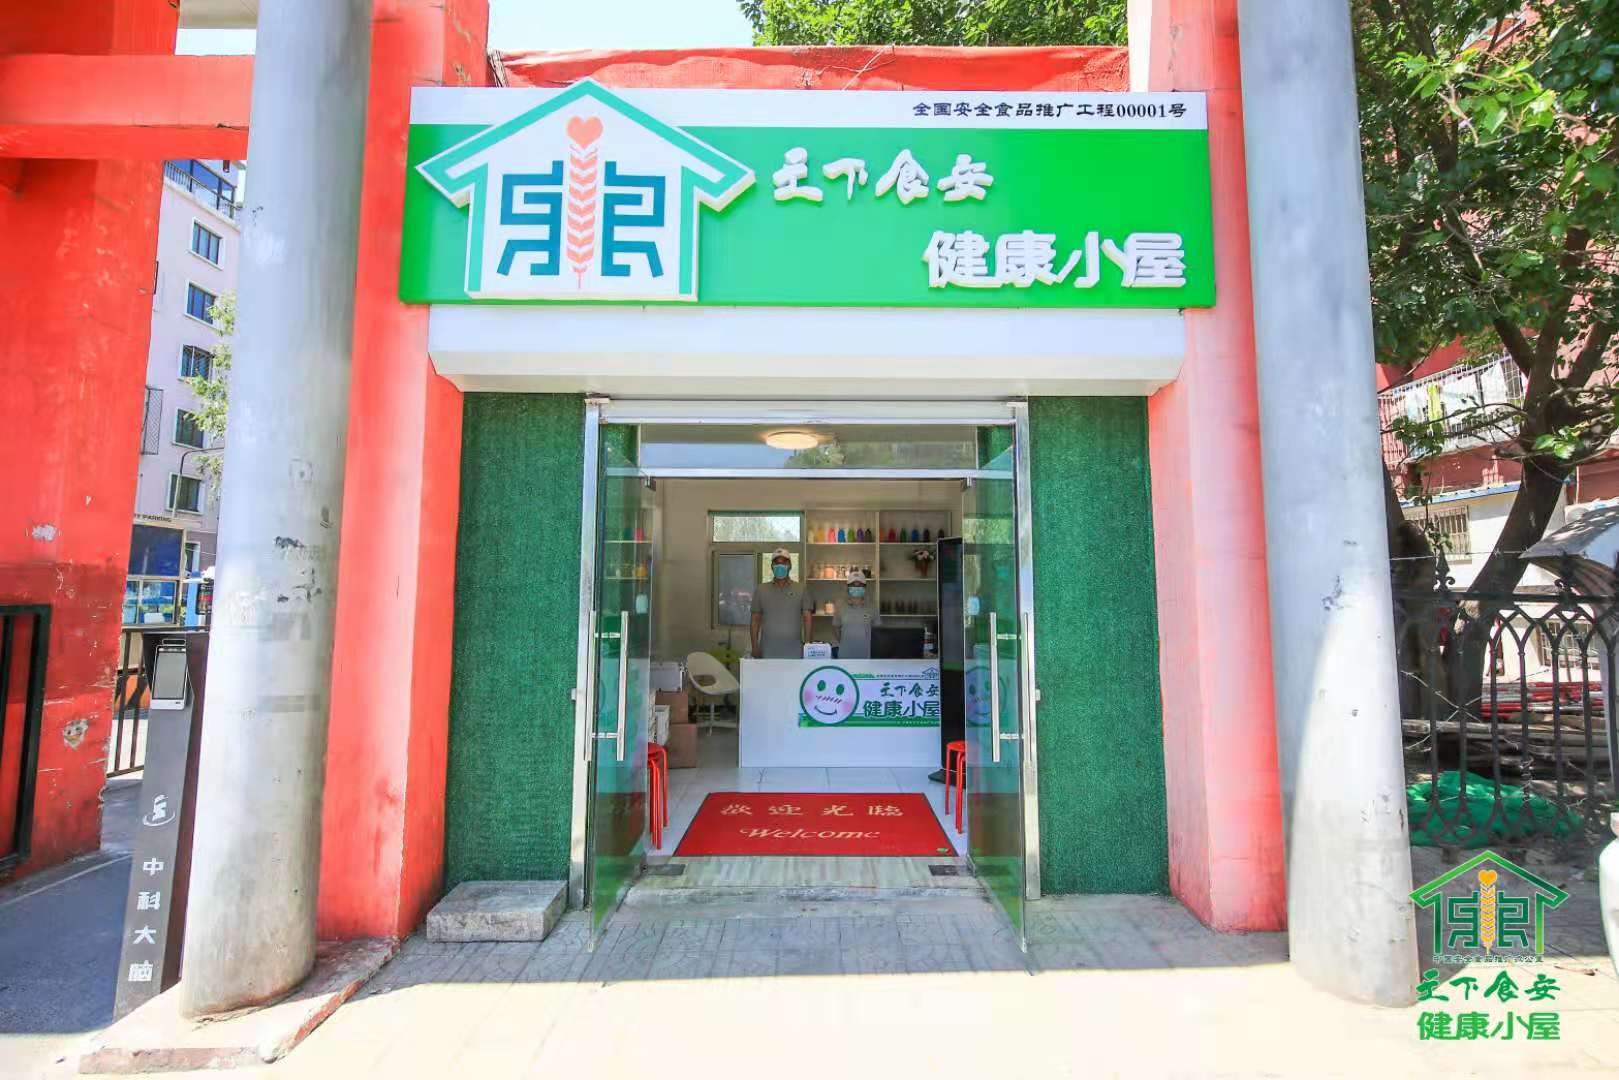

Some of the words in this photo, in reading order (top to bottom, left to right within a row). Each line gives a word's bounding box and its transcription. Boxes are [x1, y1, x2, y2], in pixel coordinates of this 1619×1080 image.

[921, 230, 1187, 288] 健康小屋
[863, 700, 940, 717] 健康小屋
[739, 828, 881, 839] Welcome
[128, 857, 165, 982] 中科大脑
